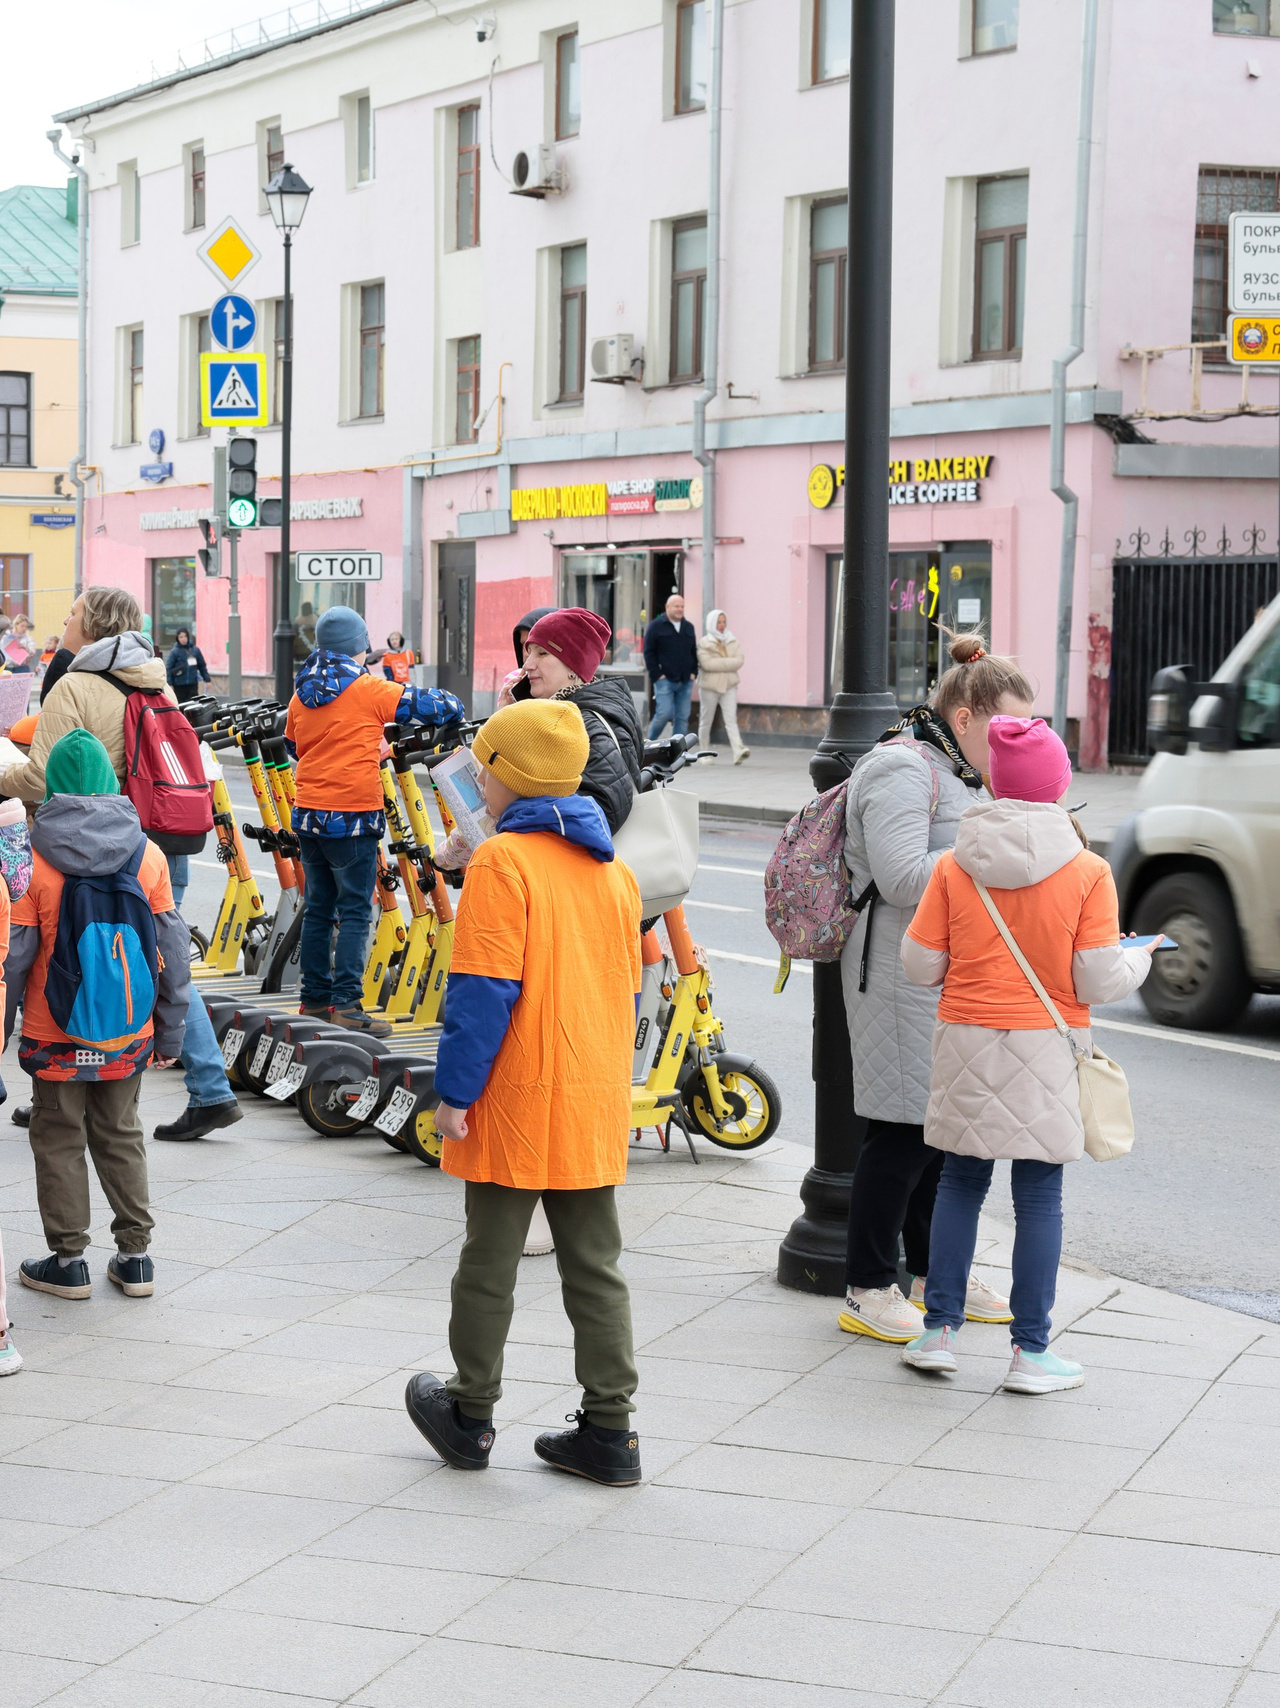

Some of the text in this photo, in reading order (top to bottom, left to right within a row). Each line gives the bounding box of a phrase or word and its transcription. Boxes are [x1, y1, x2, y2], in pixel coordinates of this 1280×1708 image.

[1243, 273, 1279, 285] ЯУЗС
[914, 456, 991, 482] BAKERY
[607, 478, 654, 495] VAPE SHOP
[918, 481, 977, 503] COFFEE
[290, 497, 363, 521] АРАВАЕВЫХ
[308, 557, 372, 576] СТОП
[391, 1090, 414, 1113] 299
[378, 1111, 404, 1132] 343
